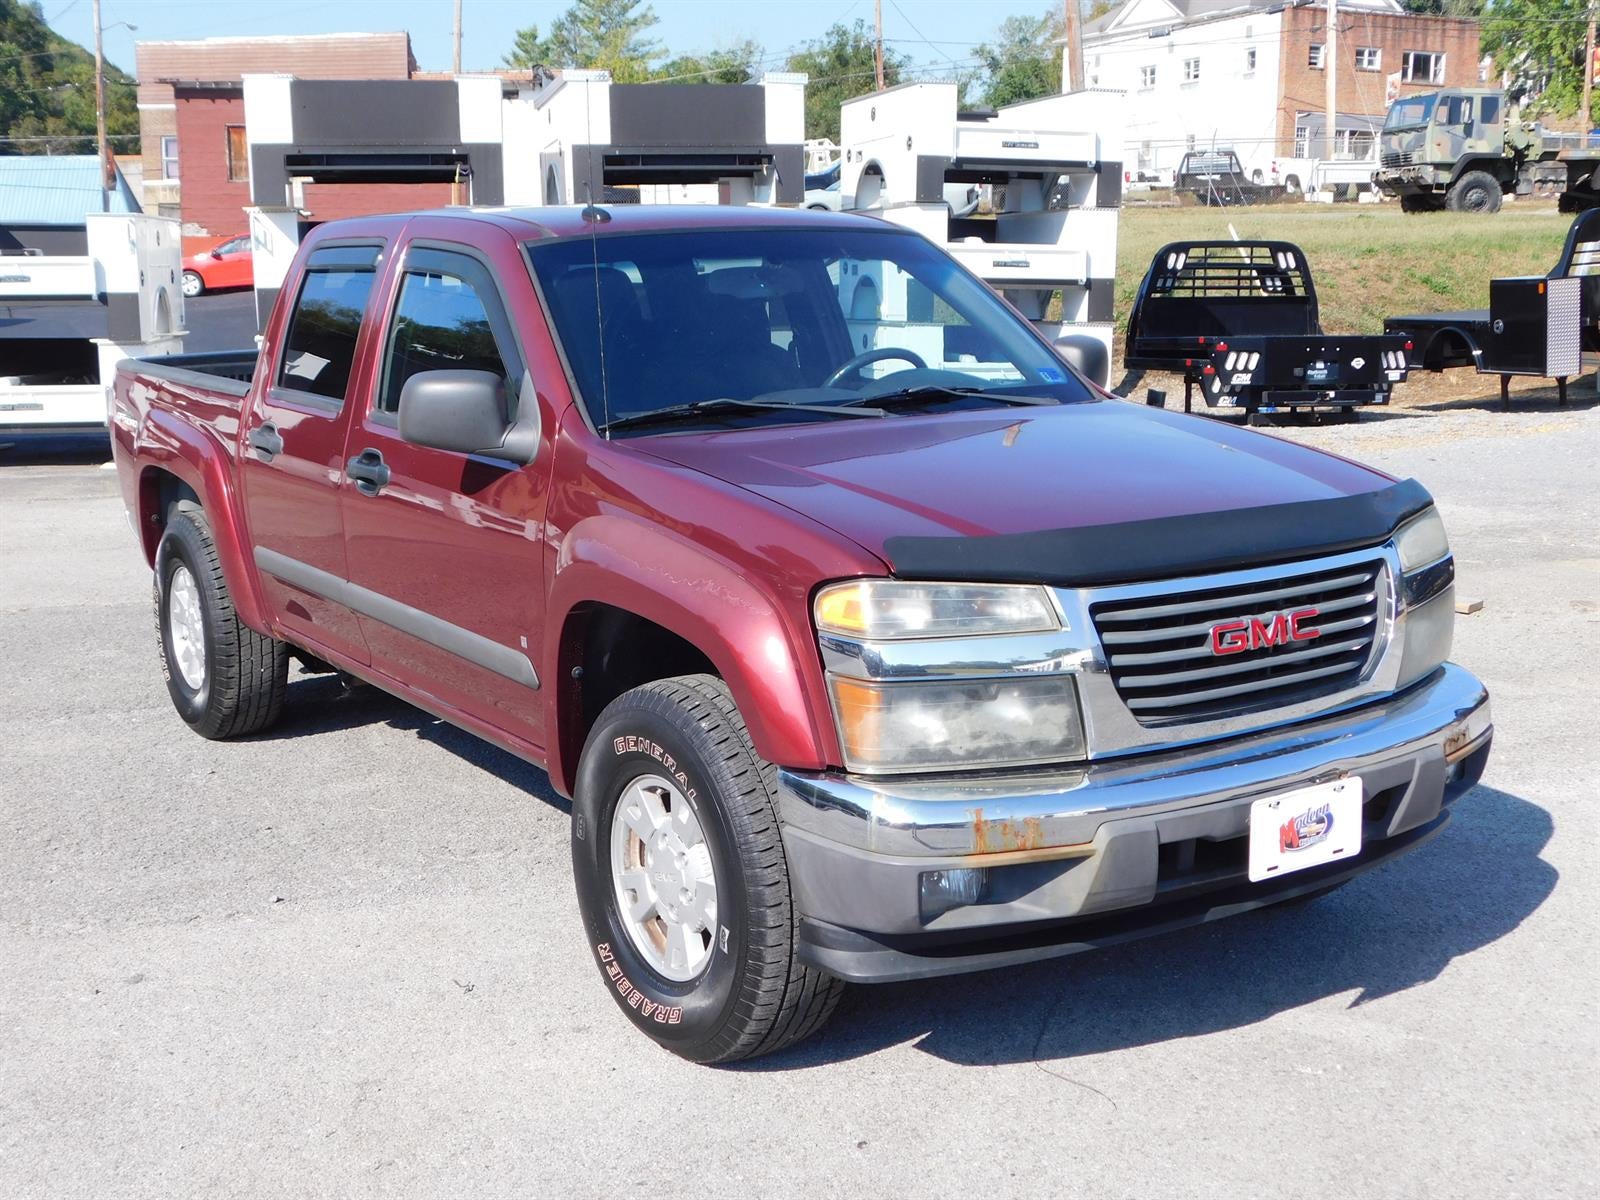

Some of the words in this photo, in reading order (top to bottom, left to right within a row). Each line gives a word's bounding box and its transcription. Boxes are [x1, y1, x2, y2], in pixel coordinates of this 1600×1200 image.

[1210, 609, 1320, 655] GMC
[613, 735, 699, 809] GENERAL
[597, 943, 683, 1024] GRABBER
